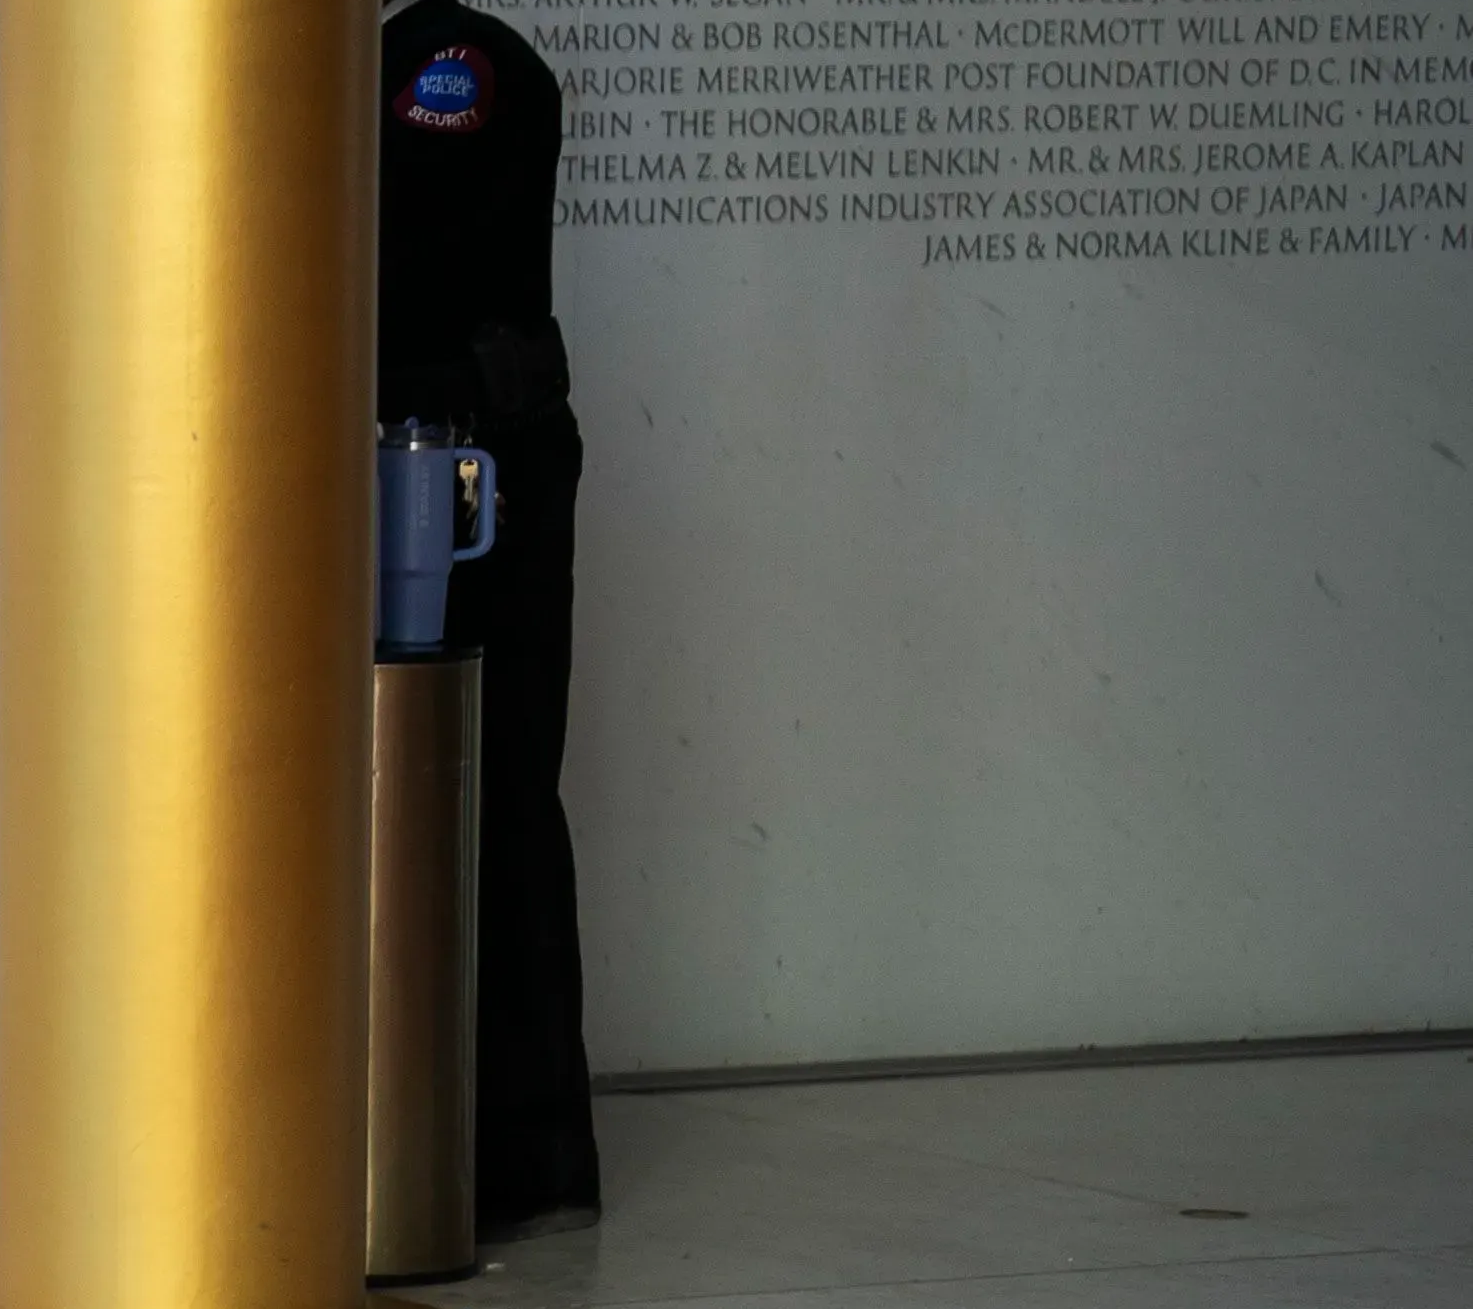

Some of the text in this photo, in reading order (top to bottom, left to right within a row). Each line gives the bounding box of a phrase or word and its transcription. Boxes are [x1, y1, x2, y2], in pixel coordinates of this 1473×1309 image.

[534, 24, 660, 52] MARION
[672, 23, 693, 50] &
[704, 23, 762, 51] BOB
[774, 20, 949, 49] ROSENTHAL
[1179, 17, 1244, 44] WILL
[1255, 15, 1318, 43] AND
[1330, 14, 1432, 42] EMERY
[555, 66, 683, 100] ARJORIE
[697, 64, 933, 93] MERRIWEATHER
[944, 61, 1014, 88] POST
[1026, 60, 1229, 89] FOUNDATION
[1240, 58, 1279, 86] OF
[1350, 57, 1381, 84] IN
[1394, 56, 1473, 84] MEM
[408, 104, 478, 126] SECURITY
[661, 109, 715, 138] THE
[727, 106, 906, 136] HONORABLE
[916, 106, 937, 134] &
[946, 105, 1014, 135] MRS.
[1024, 102, 1139, 133] ROBERT
[1149, 103, 1178, 132] W.
[1189, 100, 1344, 130] DUEMLING
[562, 153, 685, 183] THELMA
[725, 152, 747, 180] &
[755, 150, 874, 179] MELVIN
[888, 147, 1000, 177] LENKIN
[1028, 146, 1083, 174] MR.
[1088, 145, 1109, 172] &
[1118, 144, 1185, 174] MRS.
[1192, 141, 1310, 176] JEROME
[1320, 141, 1345, 170] A.
[1351, 140, 1464, 169] KAPLAN
[841, 191, 997, 222] INDUSTRY
[1003, 186, 1200, 219] ASSOCIATION
[1210, 186, 1254, 213] OF
[1257, 184, 1347, 216] JAPAN
[1375, 181, 1466, 214] JAPAN
[922, 232, 1016, 266] JAMES
[1025, 233, 1045, 259] &
[1056, 231, 1171, 259] NORMA
[1181, 228, 1270, 257] KLINE
[1279, 228, 1300, 255] &
[1309, 225, 1416, 254] FAMILY
